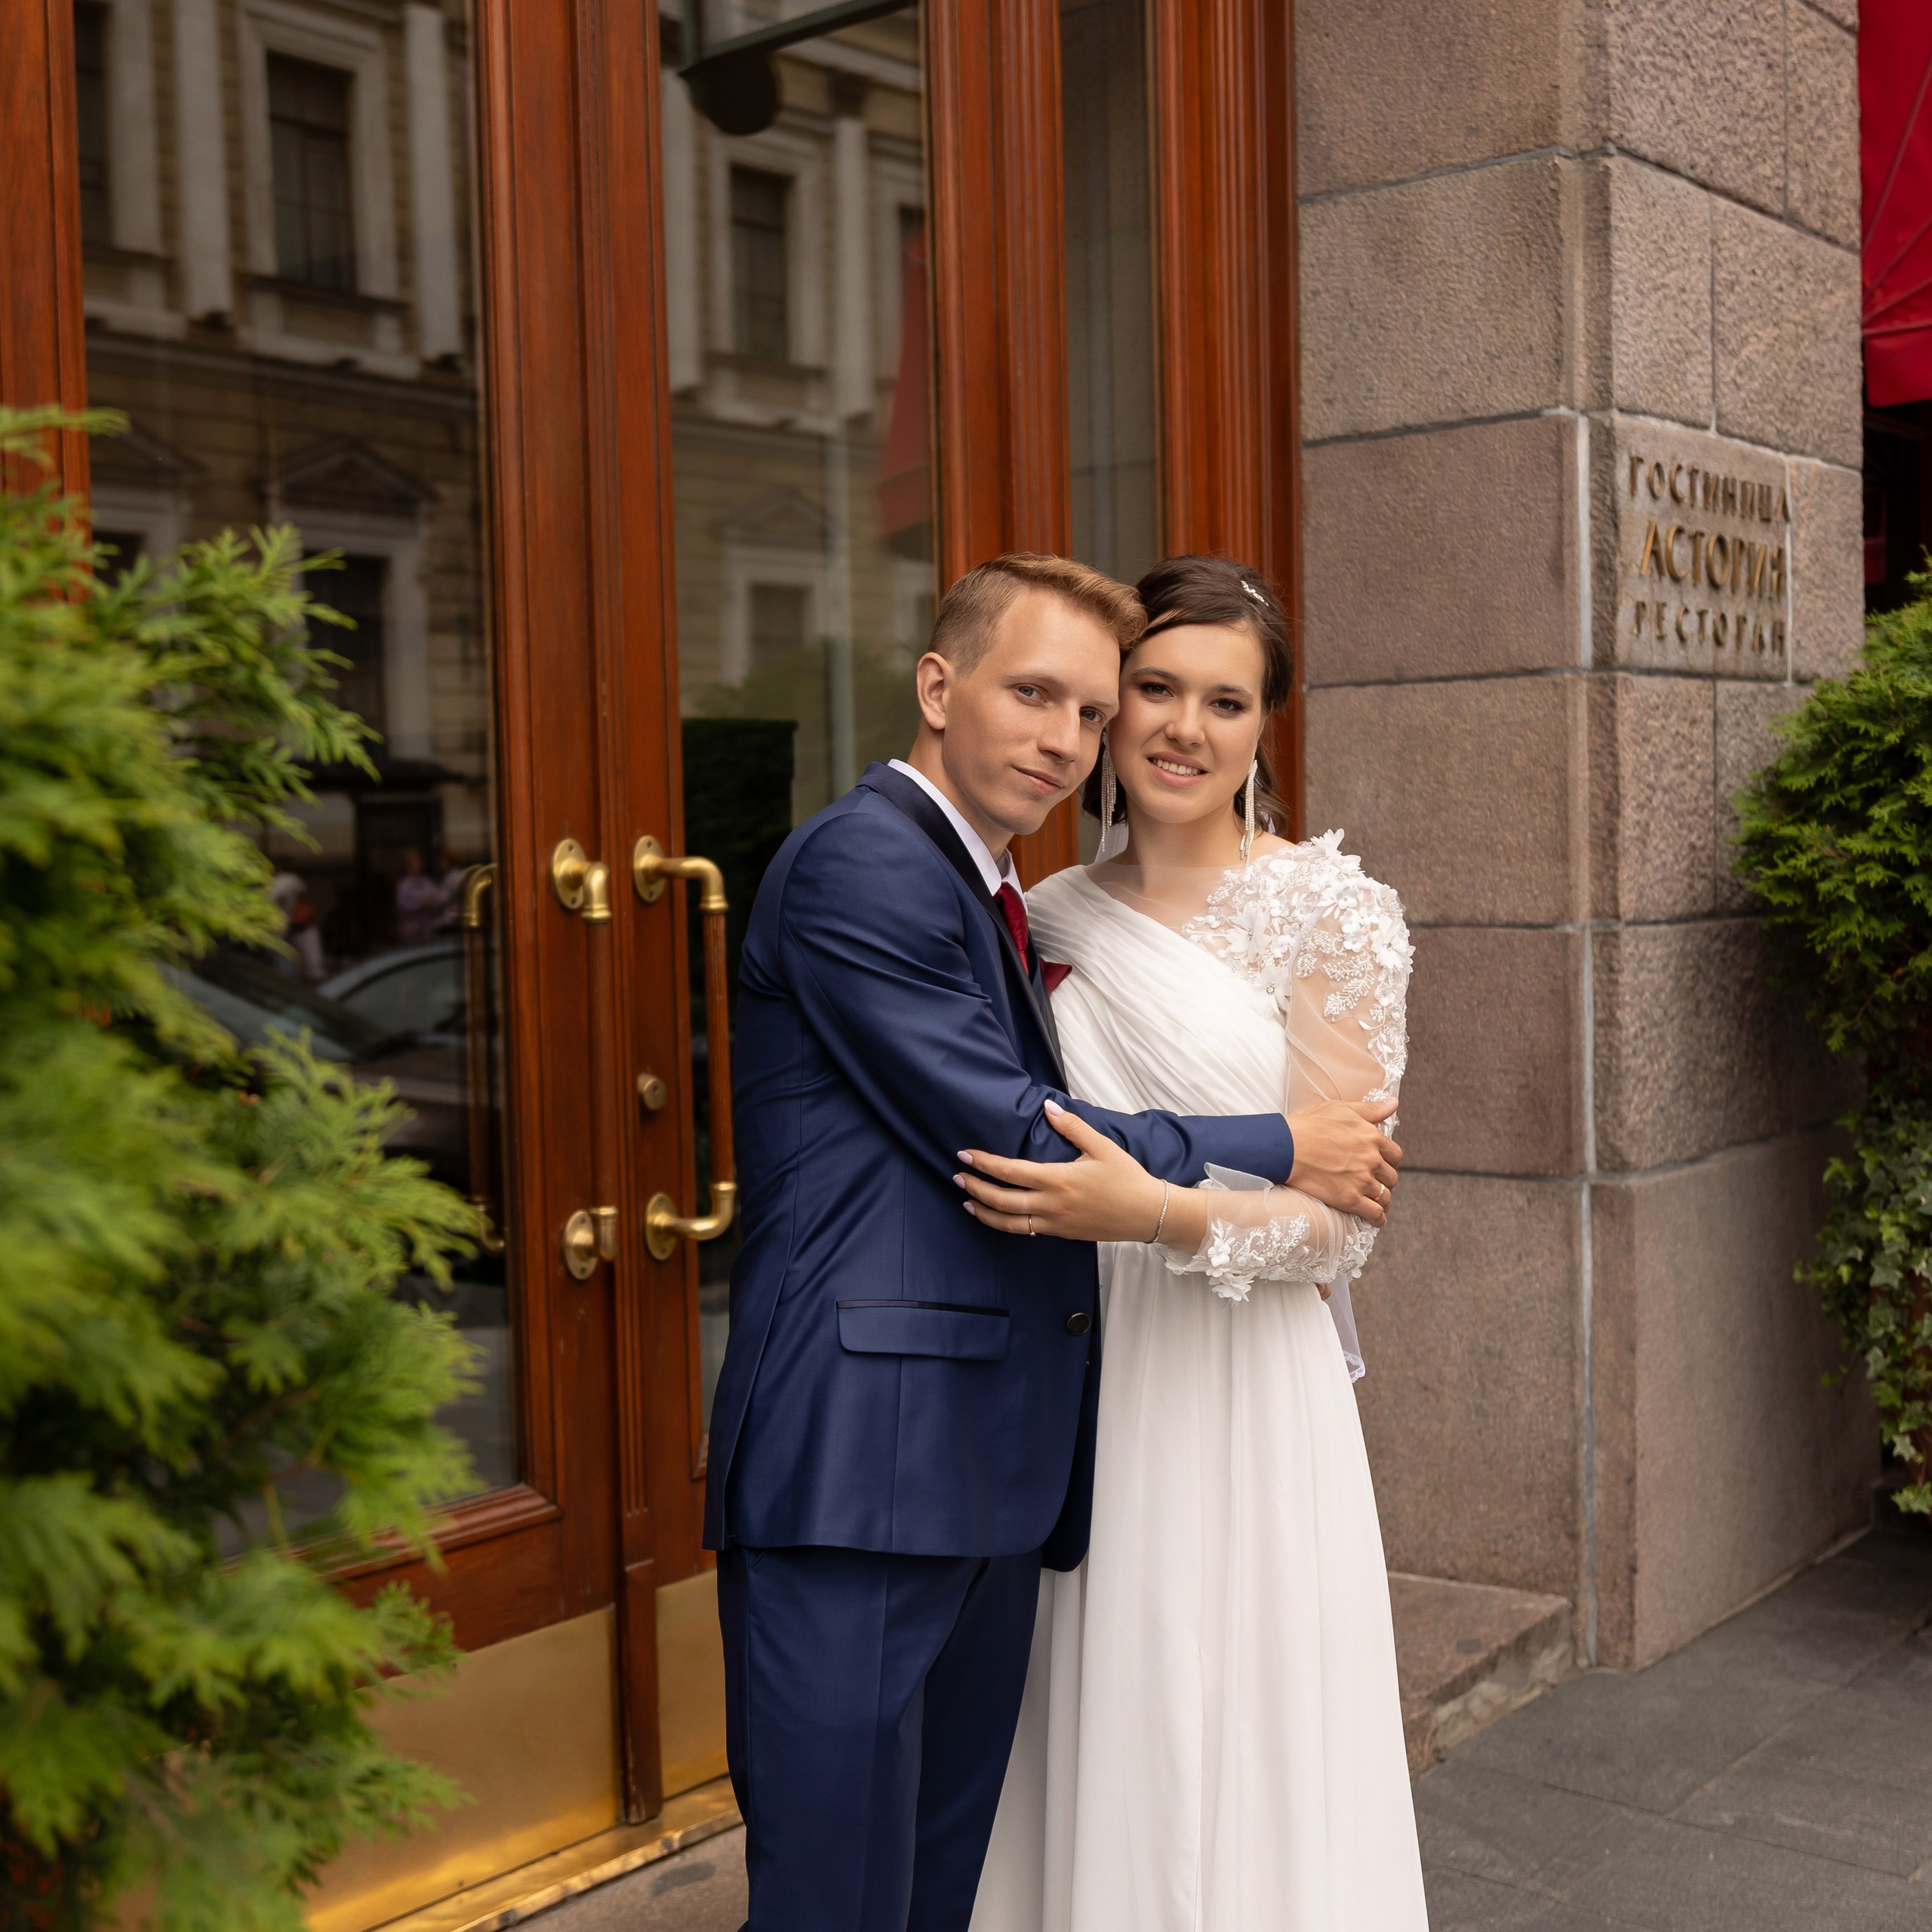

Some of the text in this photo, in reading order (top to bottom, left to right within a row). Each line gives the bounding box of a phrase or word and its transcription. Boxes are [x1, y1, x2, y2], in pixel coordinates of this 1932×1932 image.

[1629, 455, 1790, 523] ГОСТИНИЦА
[1639, 518, 1786, 601] АСТОРИЯ
[1634, 601, 1786, 656] РЕСТОРАН
